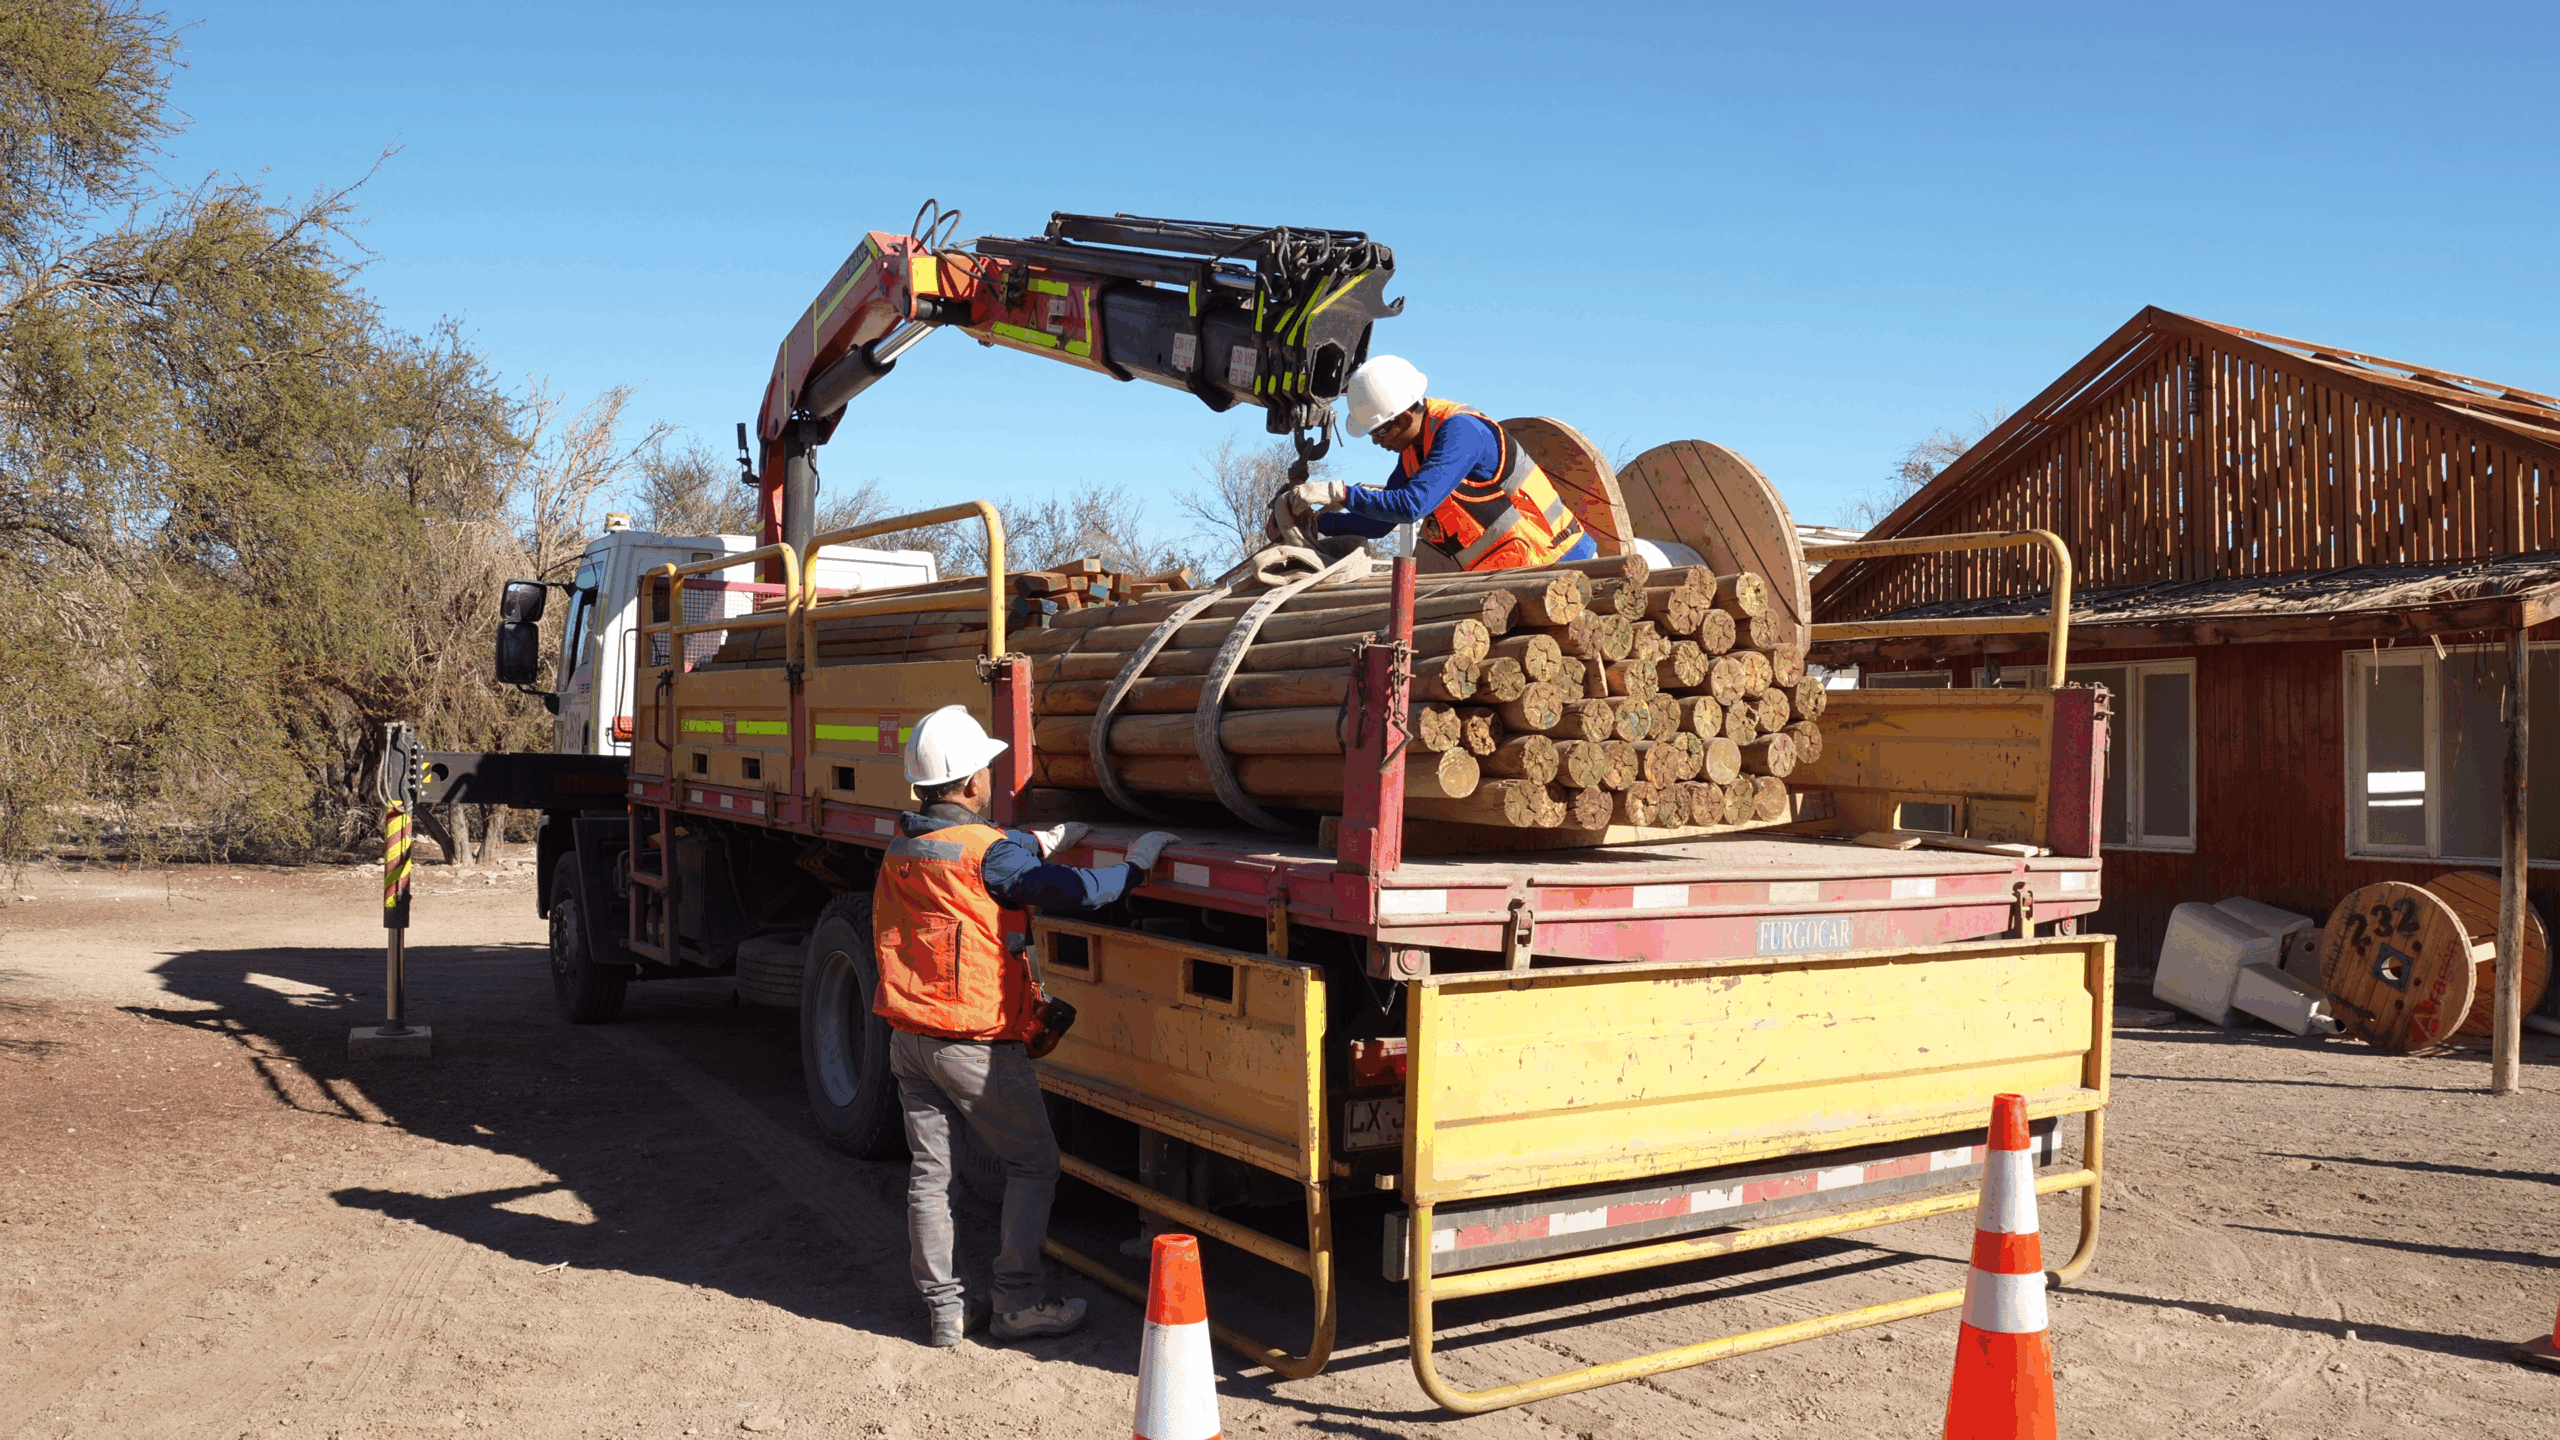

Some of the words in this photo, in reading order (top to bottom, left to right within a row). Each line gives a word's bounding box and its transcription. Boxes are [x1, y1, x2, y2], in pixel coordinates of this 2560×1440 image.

[1760, 919, 1850, 950] FURGOCAR
[2349, 897, 2420, 946] 232
[968, 1146, 1002, 1175] PIRE
